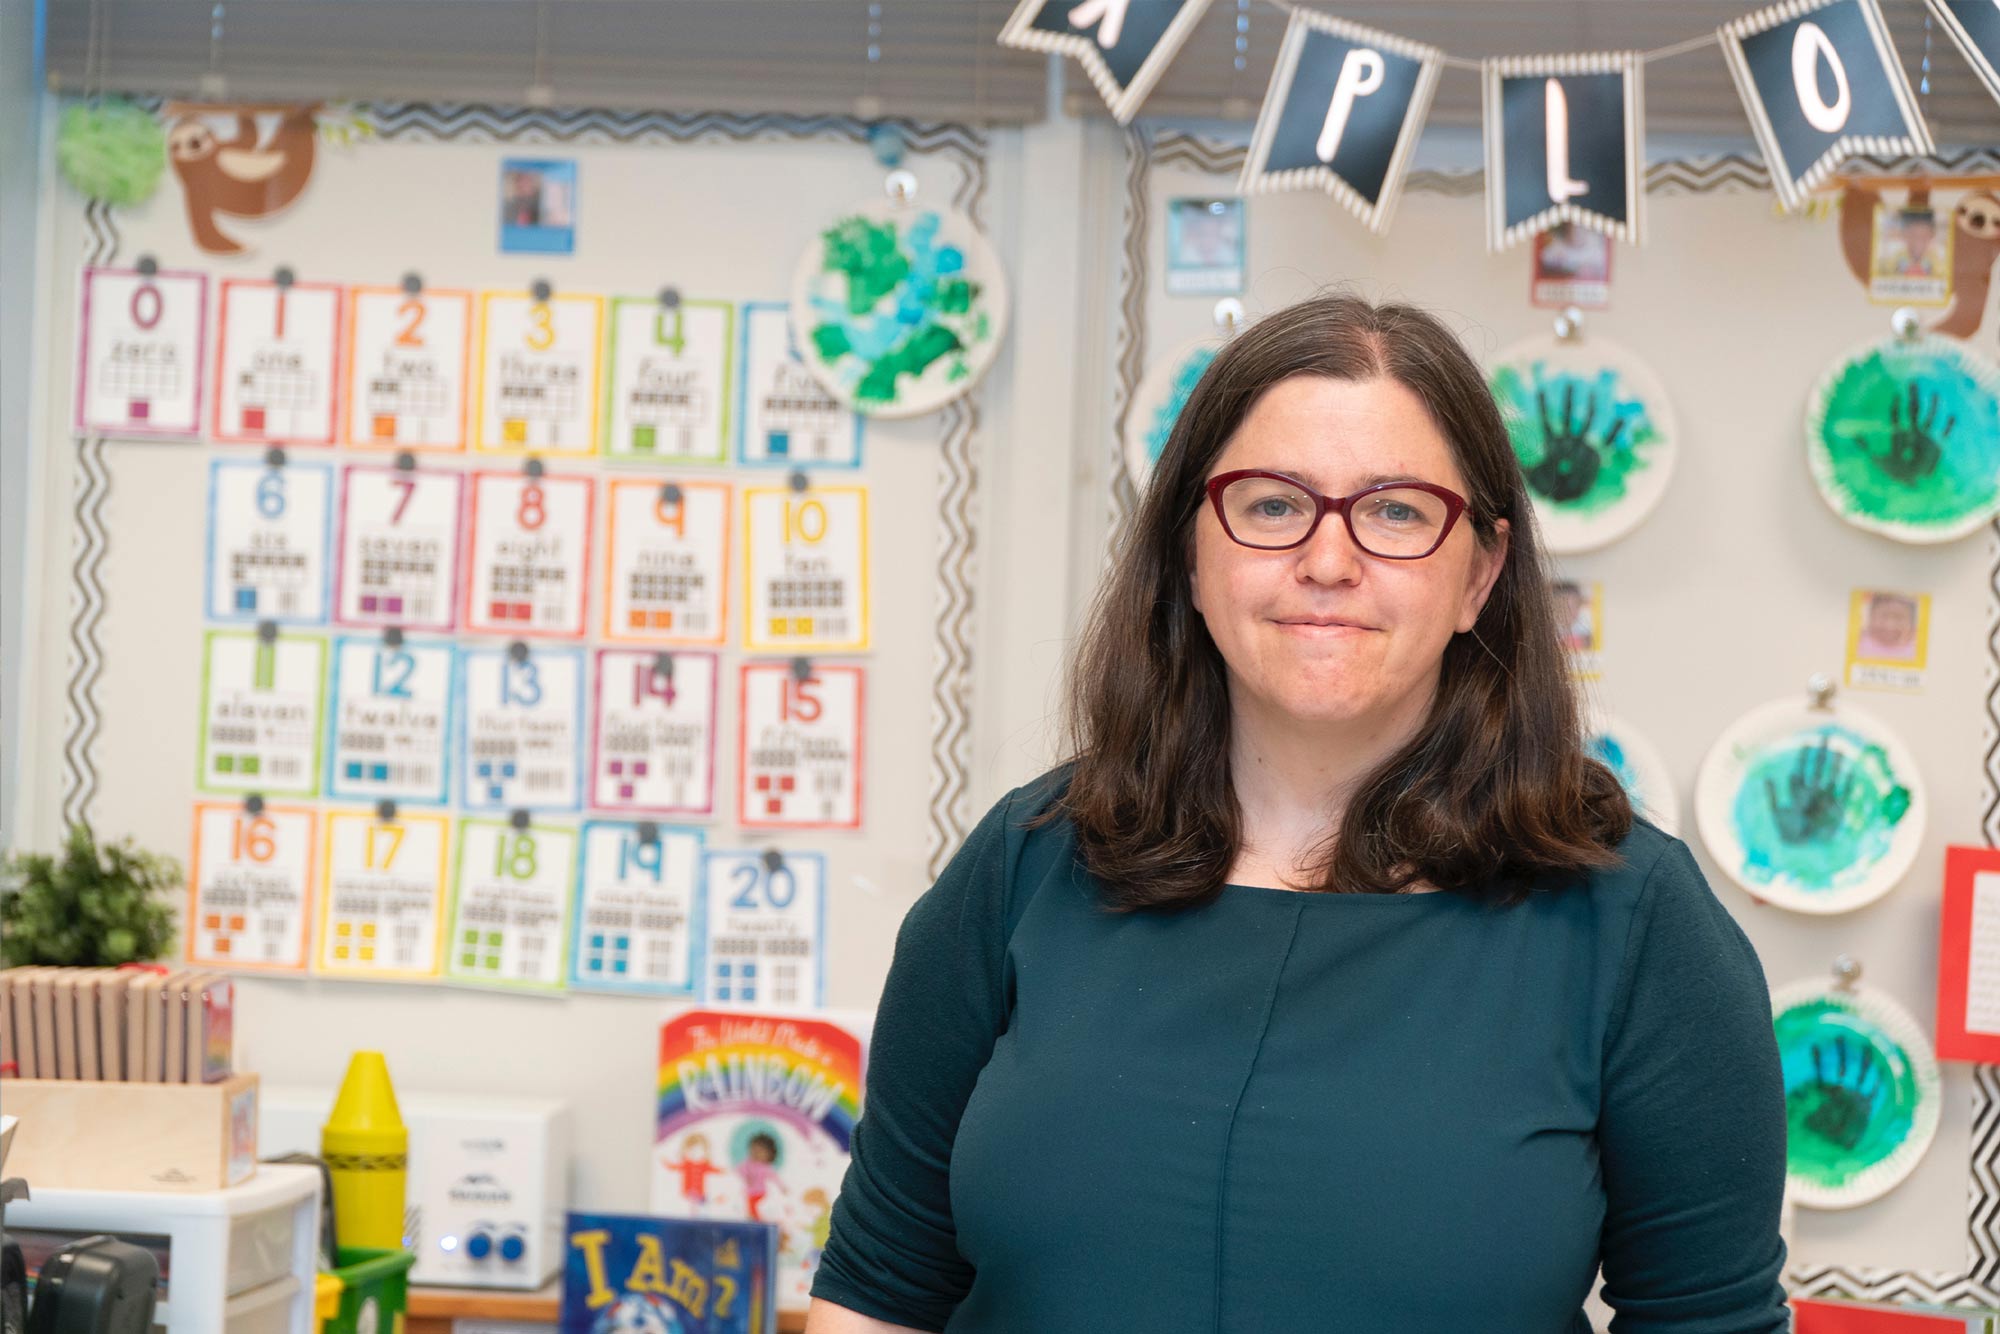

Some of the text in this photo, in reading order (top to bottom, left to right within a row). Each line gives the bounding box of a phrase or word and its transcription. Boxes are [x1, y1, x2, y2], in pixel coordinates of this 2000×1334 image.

[1316, 48, 1385, 163] P
[1545, 77, 1590, 203] L
[129, 282, 163, 331] 0
[273, 287, 287, 339] 1
[394, 300, 427, 347] 2
[524, 300, 556, 351] 3
[111, 340, 177, 364] zero
[653, 310, 686, 357] 4
[253, 350, 304, 370] one
[383, 351, 436, 378] two
[499, 352, 579, 381] three
[637, 355, 698, 386] four
[256, 470, 286, 519] 6
[389, 480, 416, 526] 7
[517, 484, 546, 531] 8
[654, 494, 685, 539] 9
[782, 498, 828, 544] 10
[372, 651, 416, 698] 12
[501, 660, 541, 706] 13
[631, 662, 677, 708] 14
[217, 692, 306, 721] eleven
[346, 701, 439, 730] twelve
[779, 676, 824, 722] 15
[231, 816, 276, 863] 16
[364, 824, 406, 870] 17
[494, 834, 537, 879] 18
[616, 836, 663, 881] 19
[729, 864, 797, 909] 20
[677, 1053, 845, 1121] RAINBOW
[570, 1229, 616, 1310] I
